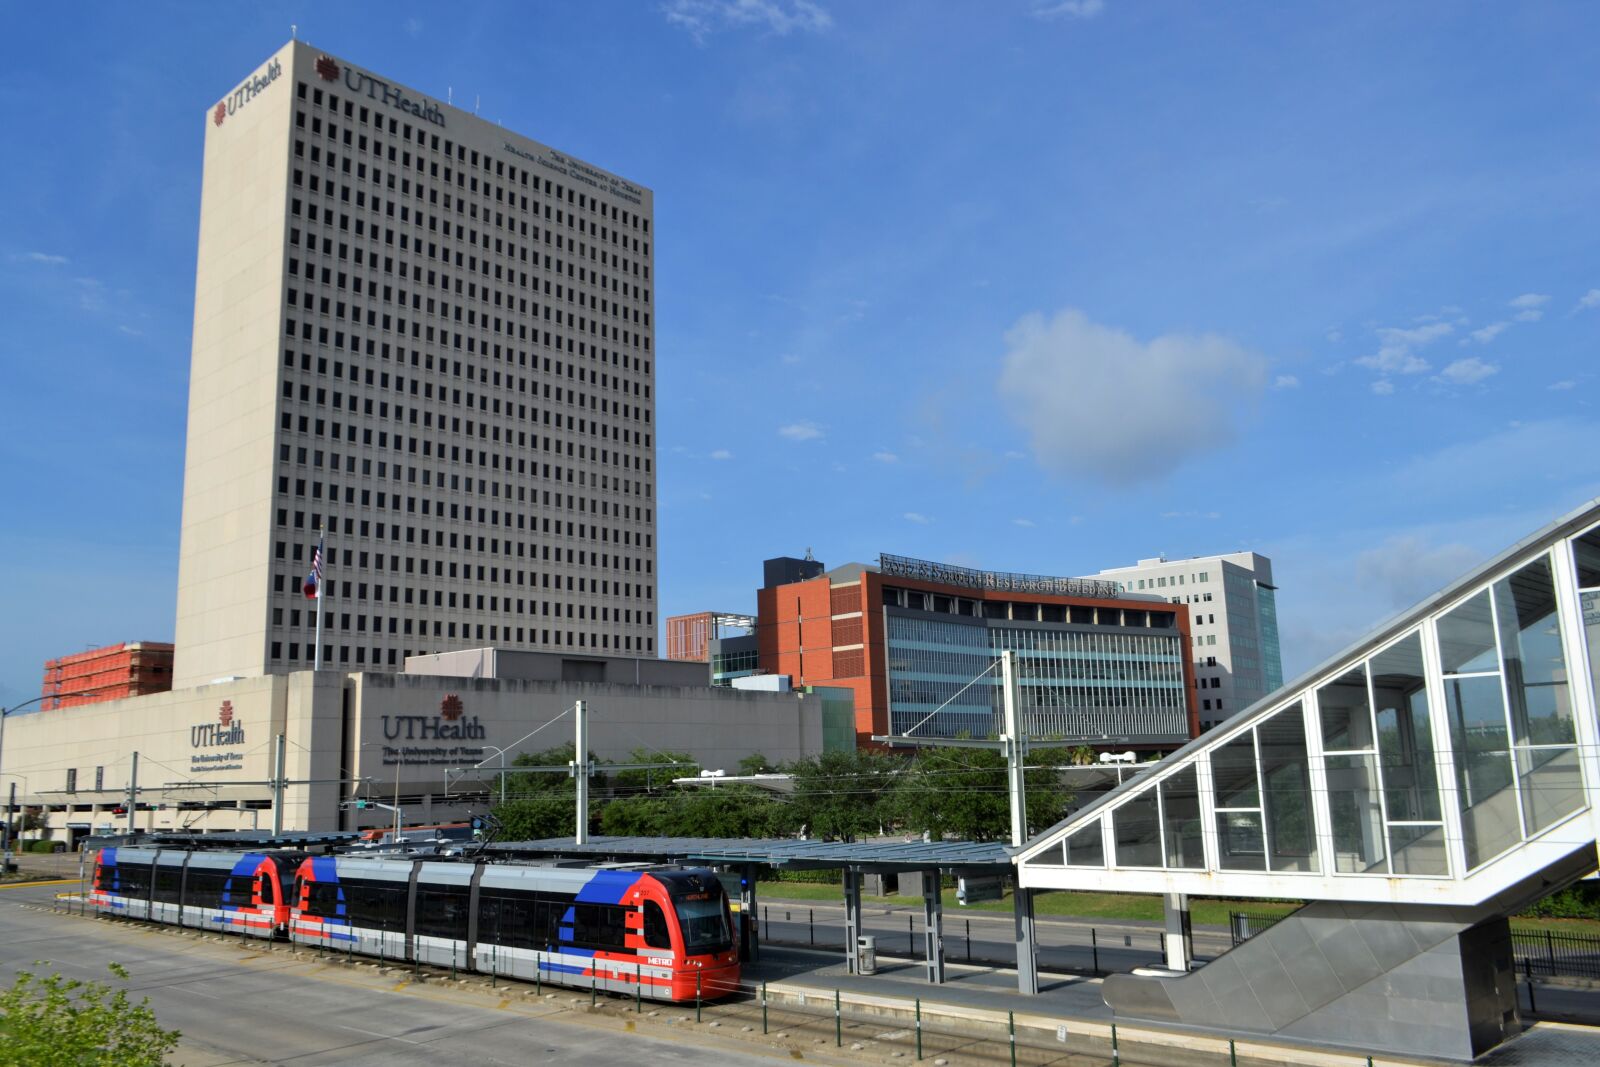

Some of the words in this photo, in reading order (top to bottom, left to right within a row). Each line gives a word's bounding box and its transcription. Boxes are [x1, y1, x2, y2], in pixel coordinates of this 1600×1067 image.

[226, 57, 282, 116] UTHealth
[343, 67, 446, 128] UTHealth
[985, 572, 1054, 591] RESEARCH
[1058, 579, 1118, 596] BUILDING
[191, 720, 245, 748] UTHealth
[381, 715, 486, 740] UTHealth
[401, 746, 447, 757] University
[647, 957, 672, 967] METRO
